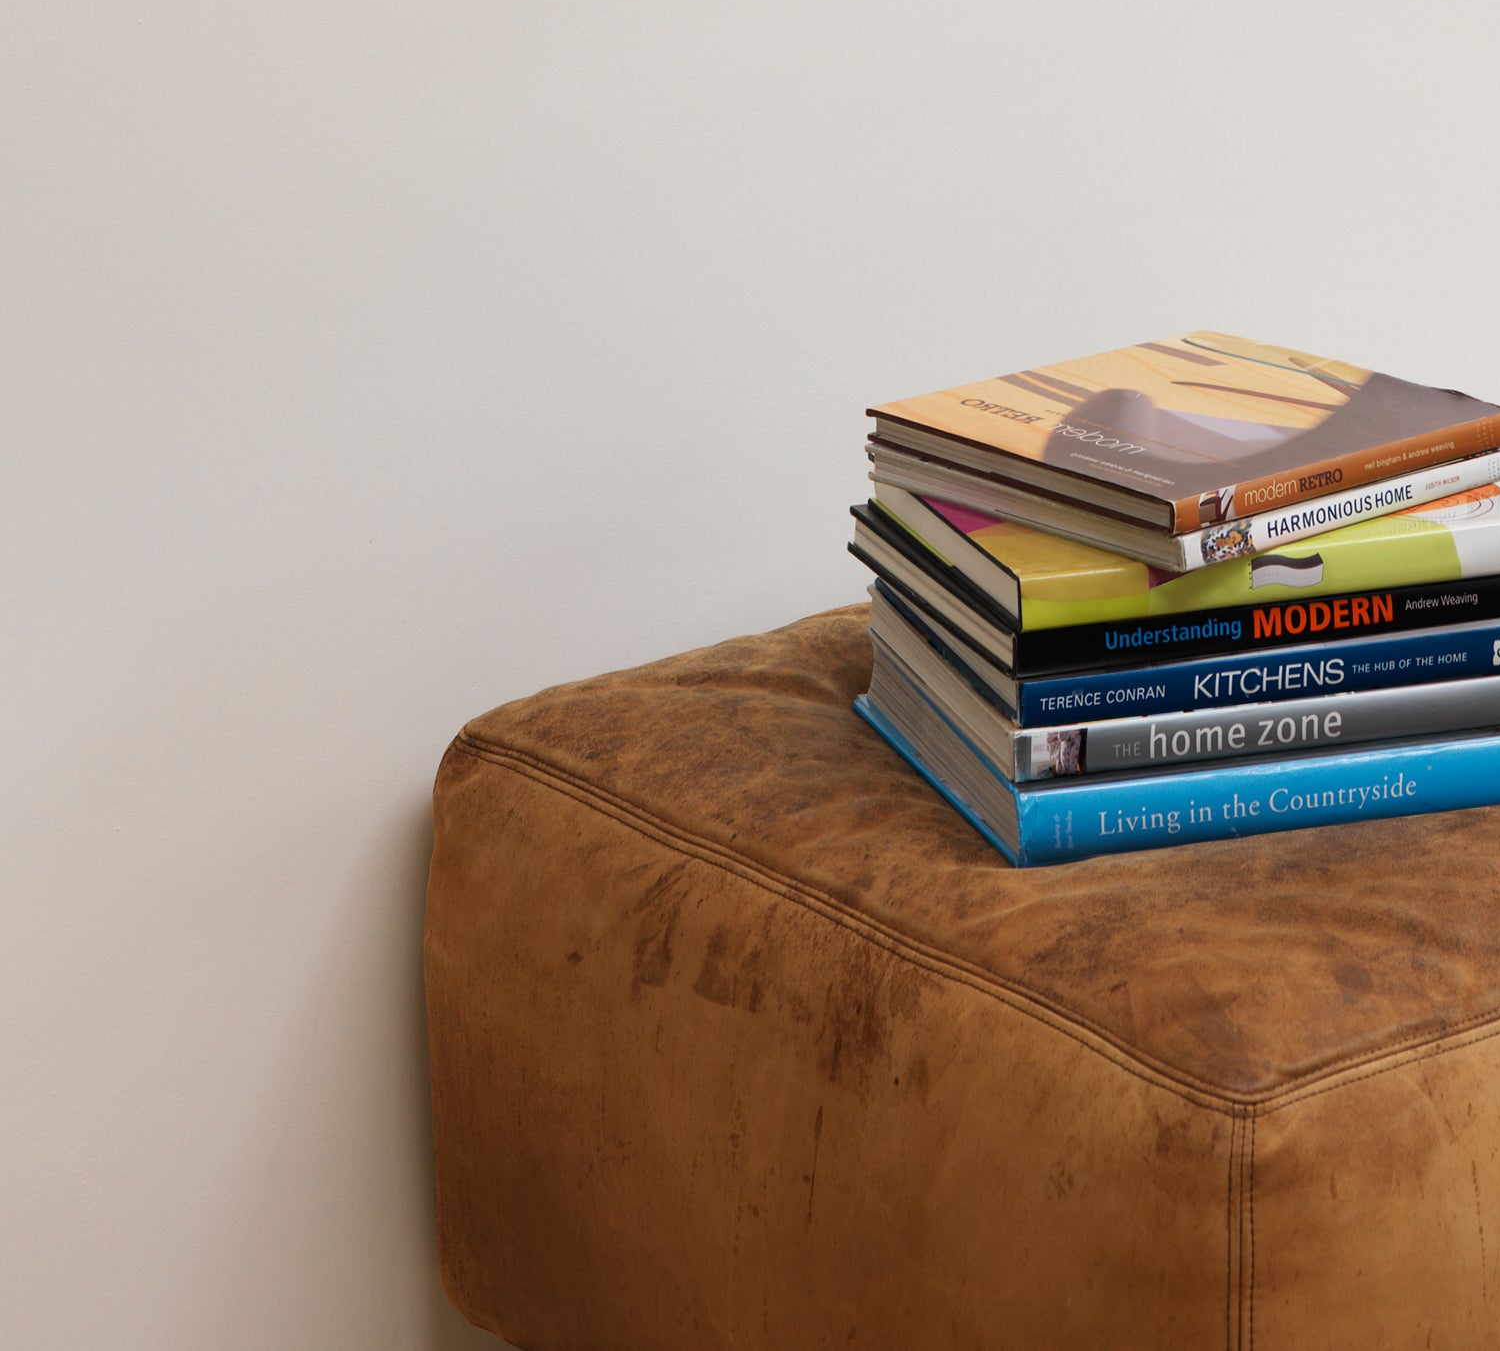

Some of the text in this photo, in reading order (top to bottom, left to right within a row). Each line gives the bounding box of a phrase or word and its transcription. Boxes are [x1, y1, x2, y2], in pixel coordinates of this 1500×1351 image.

[1376, 453, 1401, 469] bingham
[1408, 447, 1430, 460] andrew
[1431, 441, 1455, 455] weaving
[1299, 468, 1343, 493] RETRO
[1267, 495, 1372, 538] HARMONIOUS
[1376, 484, 1413, 509] HOME
[1405, 592, 1478, 611] Andrew Weaving
[1104, 594, 1394, 650] Understanding MODERN
[1194, 658, 1345, 700] KITCHENS
[1352, 652, 1468, 674] THE HUB OF THE HOME
[1040, 685, 1166, 711] TERENCE CONRAN
[1113, 710, 1342, 759] THE home zone
[1099, 807, 1181, 835] Living
[1189, 800, 1213, 824] in
[1223, 793, 1261, 818] the
[1269, 772, 1417, 813] Countryside
